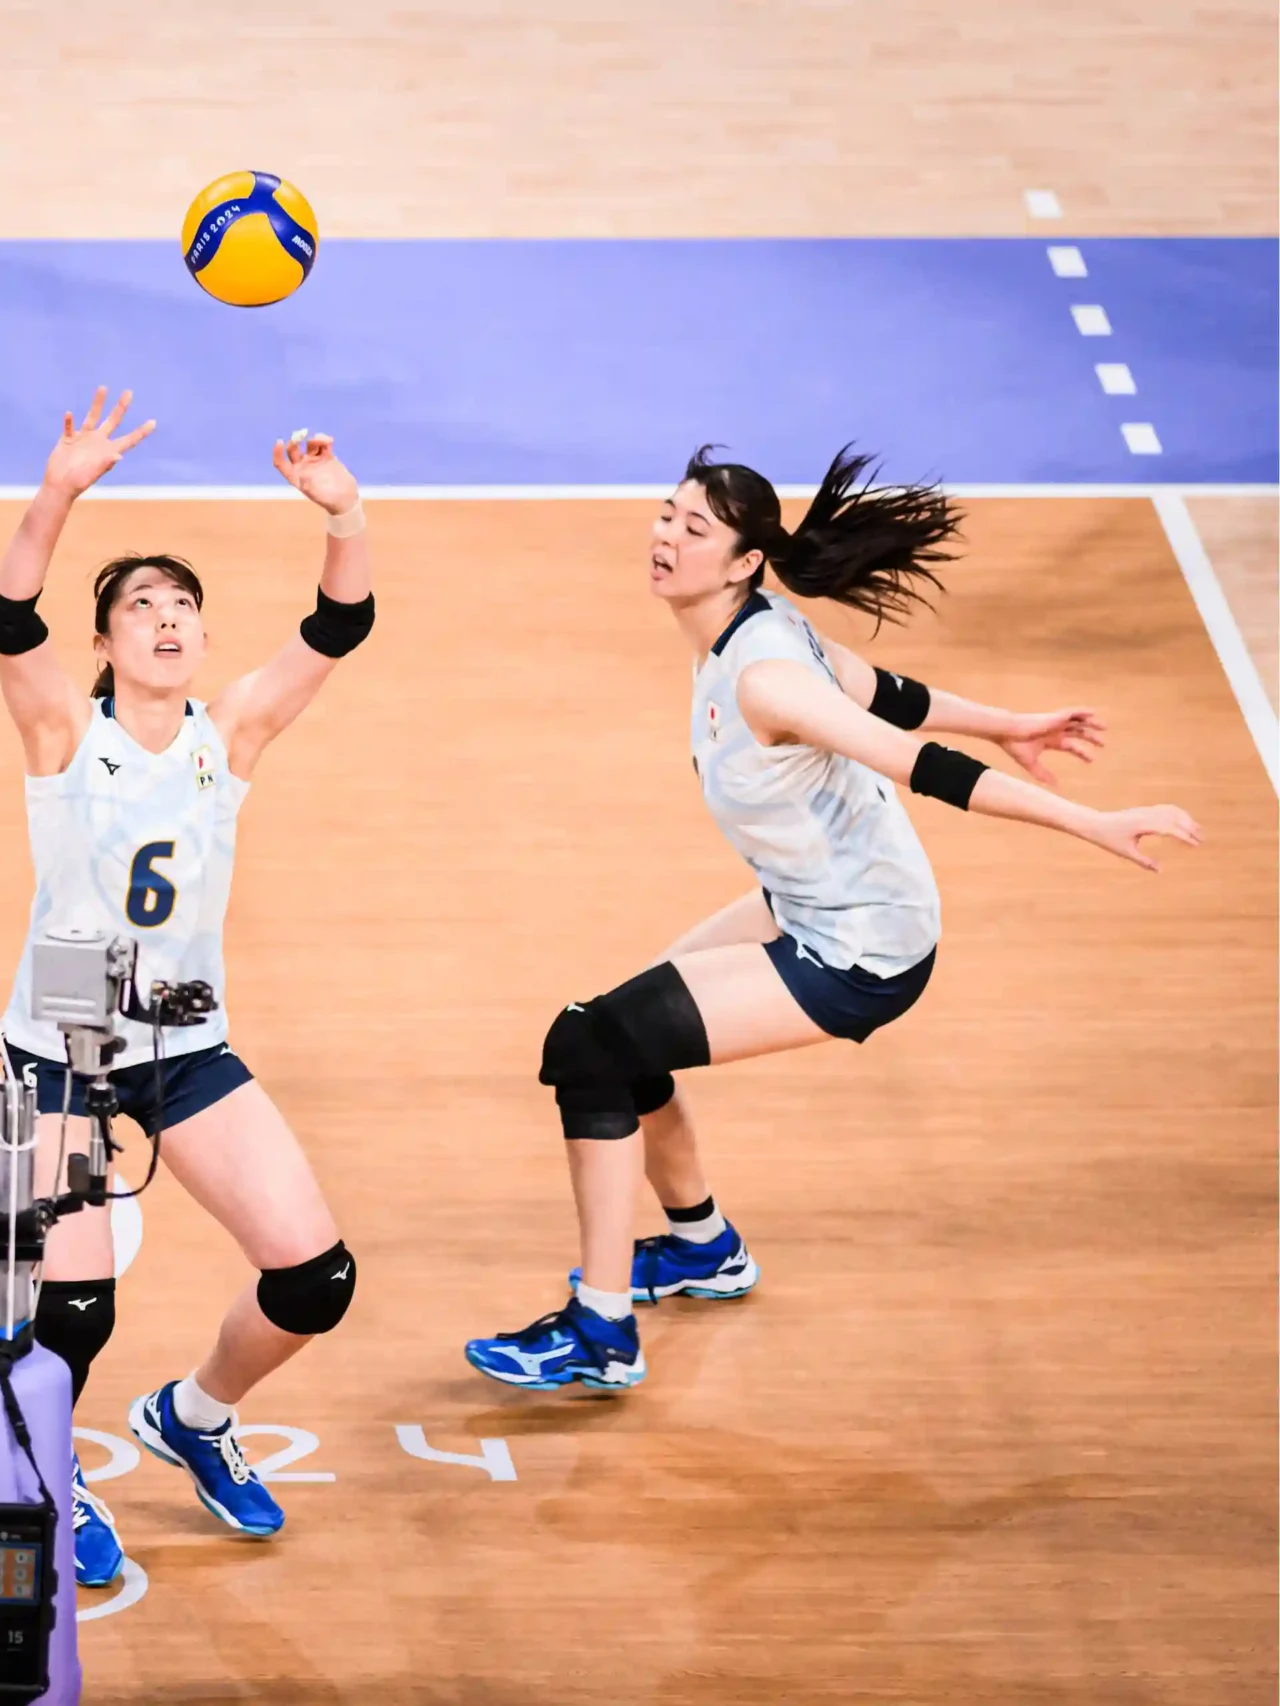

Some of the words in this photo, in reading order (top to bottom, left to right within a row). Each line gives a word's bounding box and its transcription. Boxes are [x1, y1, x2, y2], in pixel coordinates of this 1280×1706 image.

[191, 231, 210, 265] PARIS
[210, 204, 241, 233] 2024
[125, 840, 177, 928] 6
[7, 1629, 24, 1644] 15
